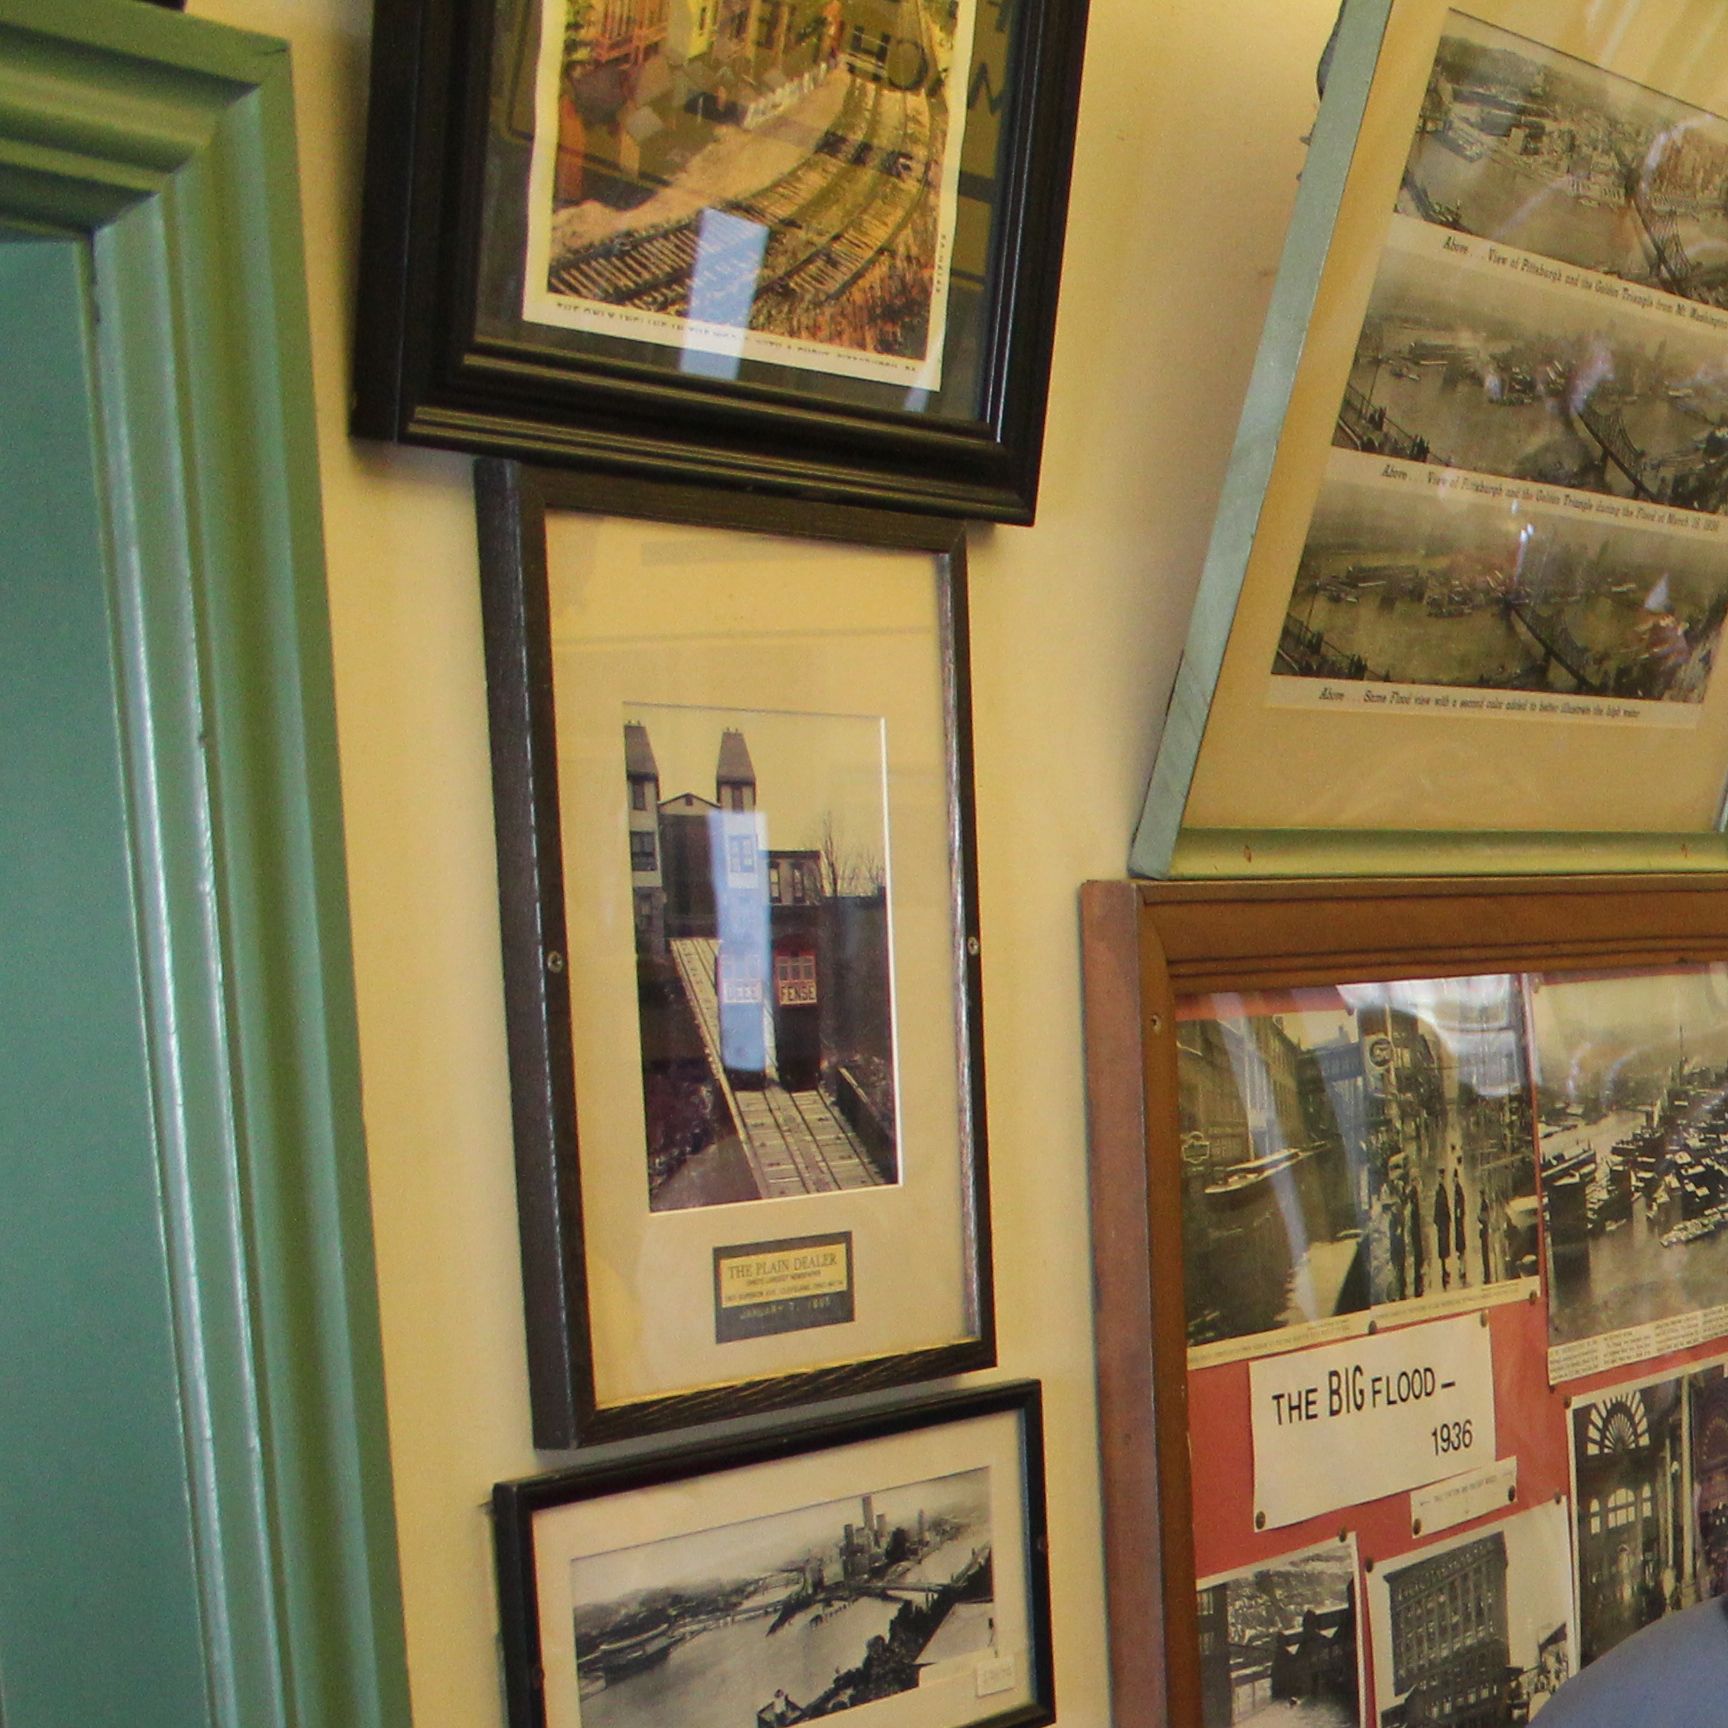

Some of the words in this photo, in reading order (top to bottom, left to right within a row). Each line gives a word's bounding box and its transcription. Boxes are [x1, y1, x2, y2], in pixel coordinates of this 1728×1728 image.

[1521, 258, 1562, 282] Pittsburgh
[1622, 287, 1653, 309] Triangle
[728, 1264, 753, 1280] THE
[755, 1259, 789, 1277] PLAIN
[794, 1252, 837, 1271] DEALER
[1271, 1388, 1318, 1425] THE
[1328, 1364, 1364, 1417] BIG
[1431, 1419, 1473, 1456] 1936
